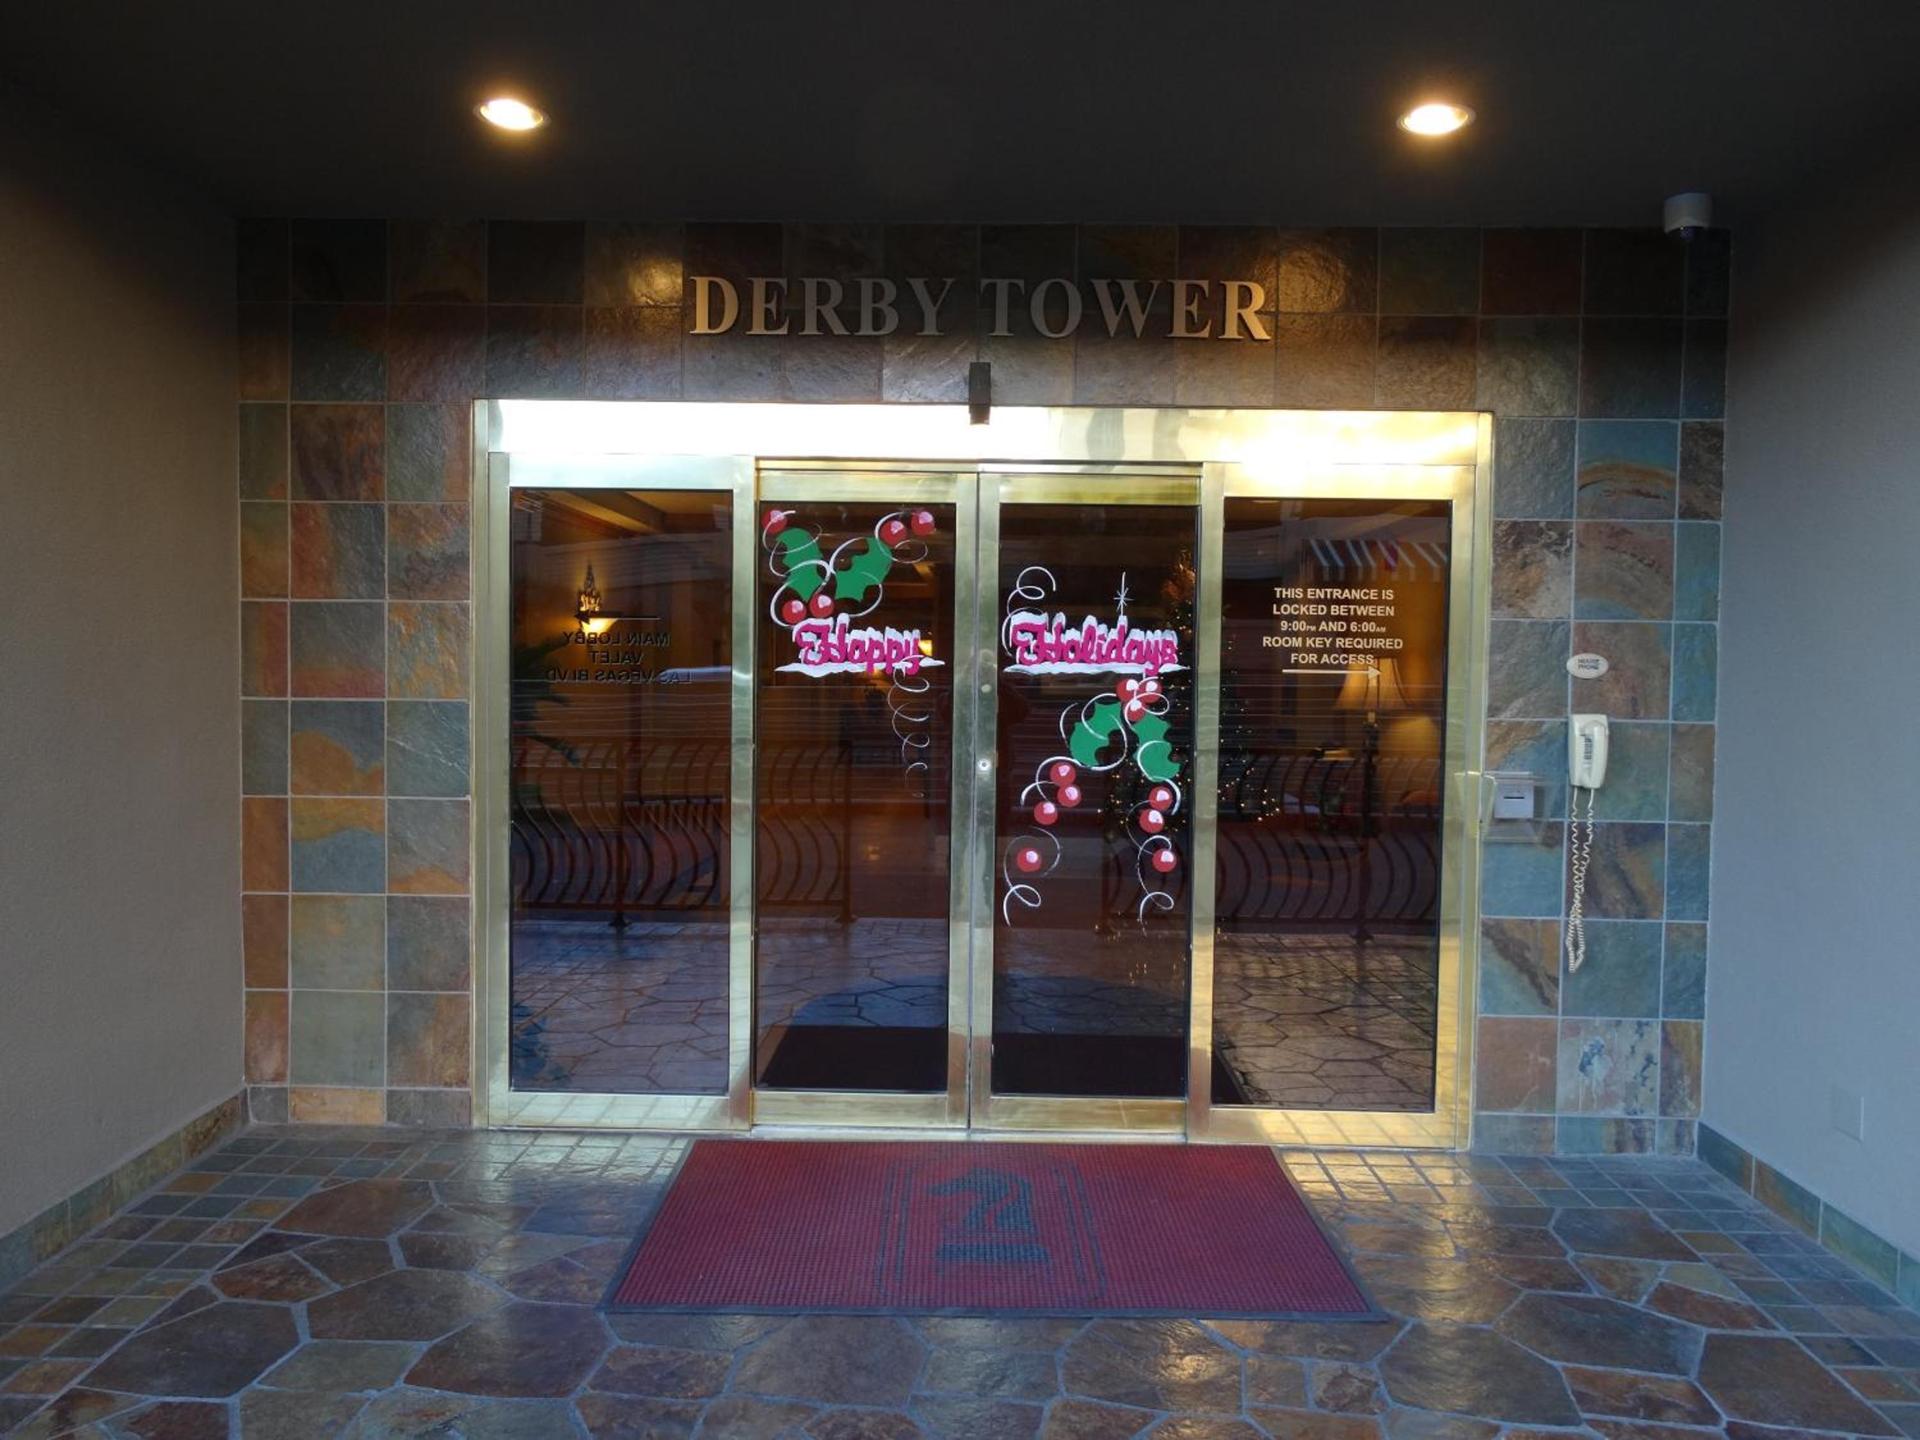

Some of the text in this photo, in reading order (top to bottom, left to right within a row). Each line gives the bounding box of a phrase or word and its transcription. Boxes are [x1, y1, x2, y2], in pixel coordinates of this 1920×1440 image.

[688, 275, 1272, 341] DERBY TOWER
[1274, 587, 1394, 600] THIS ENTRANCE IS
[1272, 603, 1395, 617] LOCKED BETWEEN
[1318, 621, 1347, 632] AND
[793, 611, 1179, 676] Happy Holidays
[1262, 636, 1404, 650] ROOM KEY REQUIRED
[1290, 653, 1375, 665] FOR ACCESS
